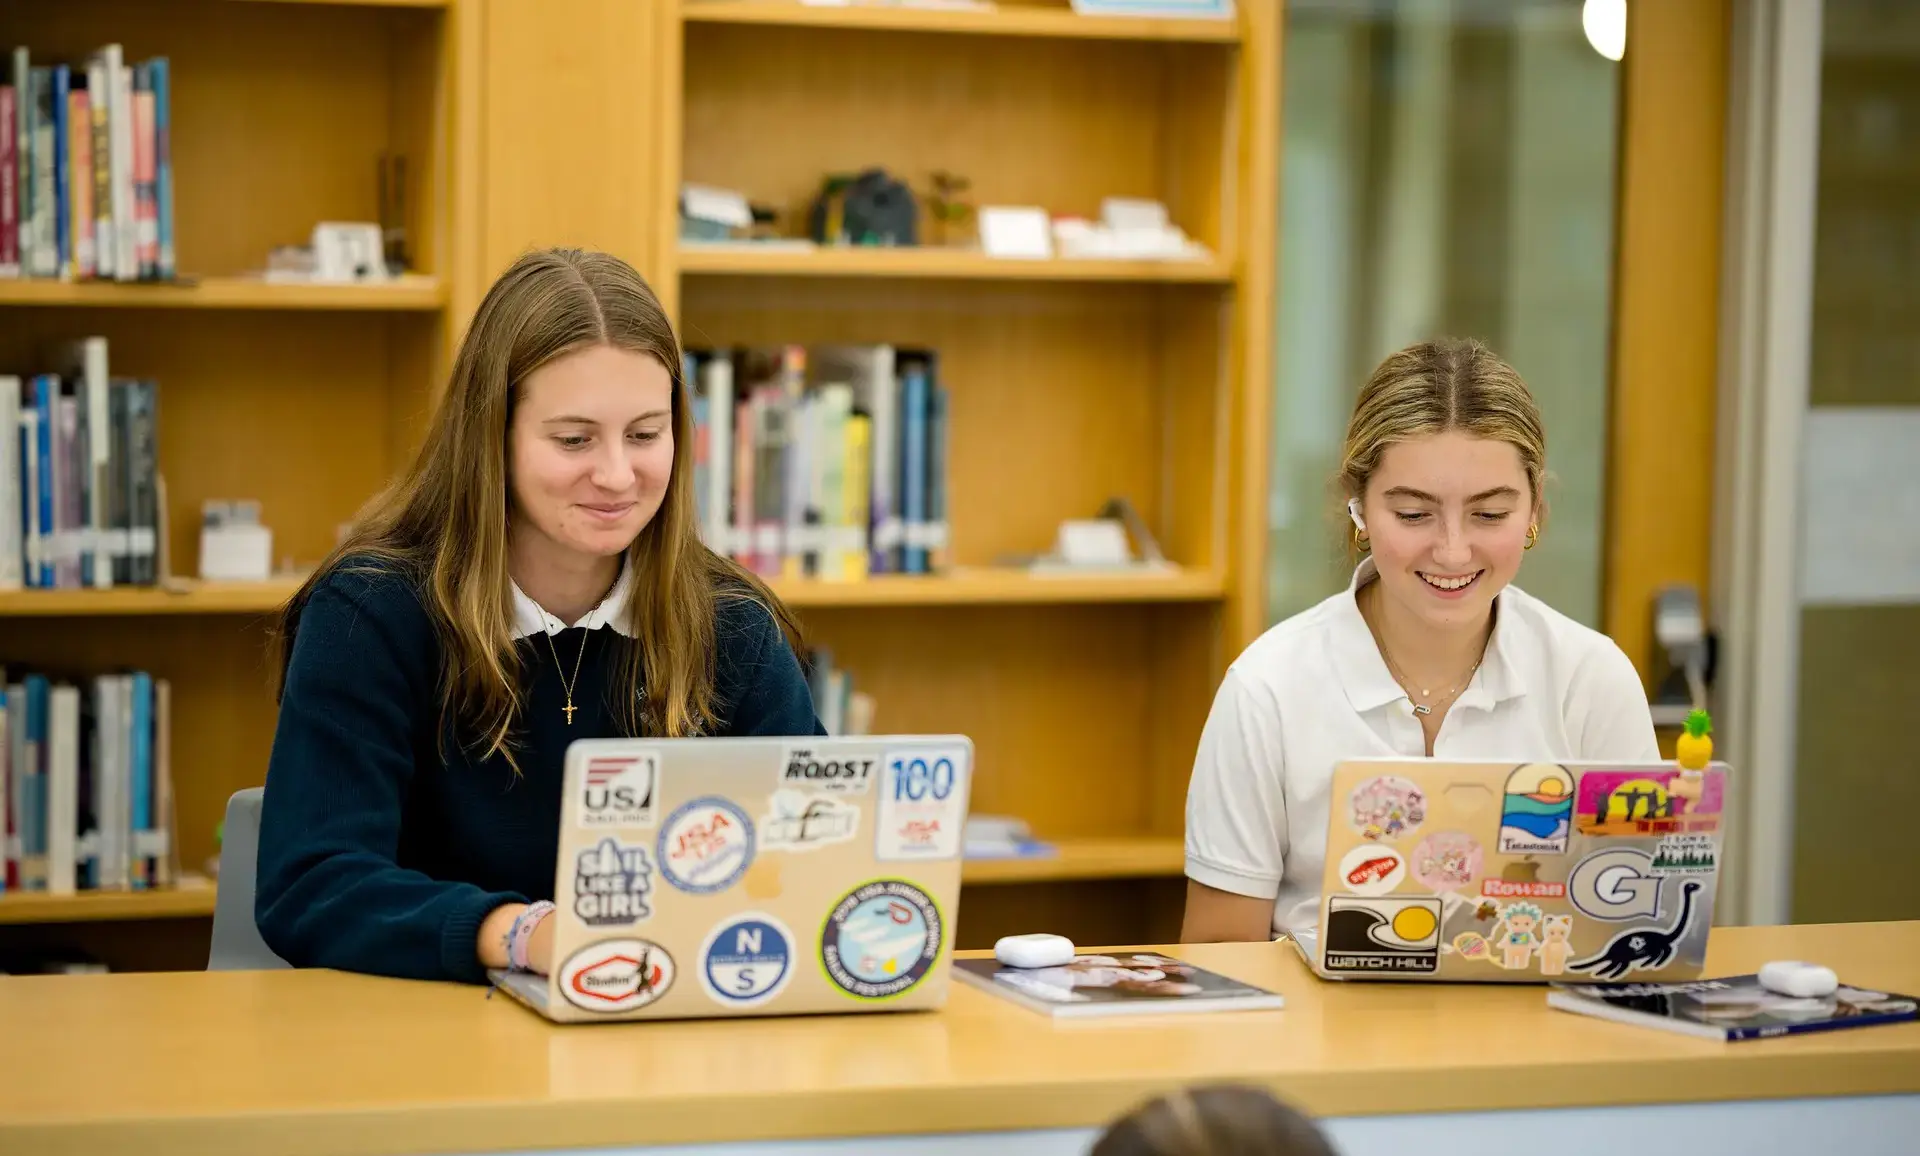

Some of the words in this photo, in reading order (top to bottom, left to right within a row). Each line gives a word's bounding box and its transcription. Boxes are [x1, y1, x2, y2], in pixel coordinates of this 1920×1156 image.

[786, 760, 873, 780] ROOST
[890, 758, 954, 801] 100
[578, 839, 651, 876] SAIL
[576, 876, 626, 894] LIKE
[630, 876, 649, 893] A
[1484, 880, 1564, 897] Rowan
[1571, 848, 1663, 920] G
[575, 894, 650, 918] GIRL
[736, 928, 762, 954] N
[1328, 957, 1393, 968] WATCH
[1396, 957, 1434, 969] HILL
[737, 968, 755, 991] S
